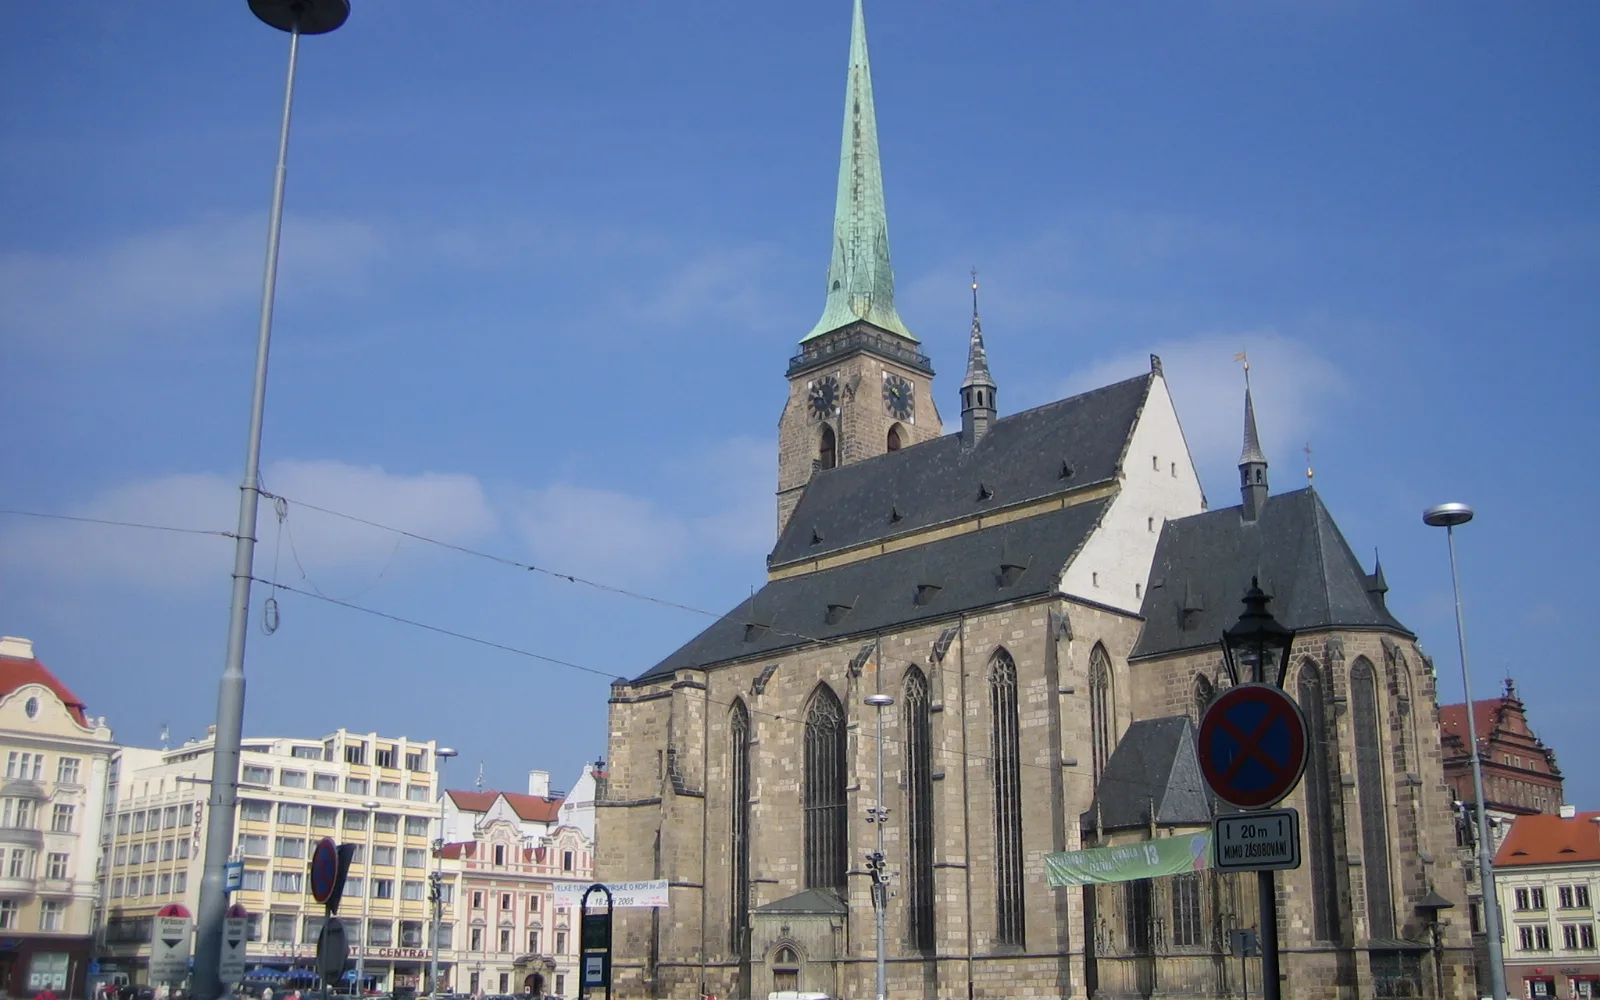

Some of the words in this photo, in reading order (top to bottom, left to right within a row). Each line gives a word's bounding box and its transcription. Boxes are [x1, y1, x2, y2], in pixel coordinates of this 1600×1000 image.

[1240, 824, 1256, 839] 20
[1257, 827, 1268, 838] m
[1142, 844, 1160, 865] 13
[1224, 842, 1243, 860] MIMO
[1243, 840, 1287, 858] ZÁSOBOVÁNÍ
[617, 897, 634, 906] 2005
[378, 948, 433, 959] CENTRAL
